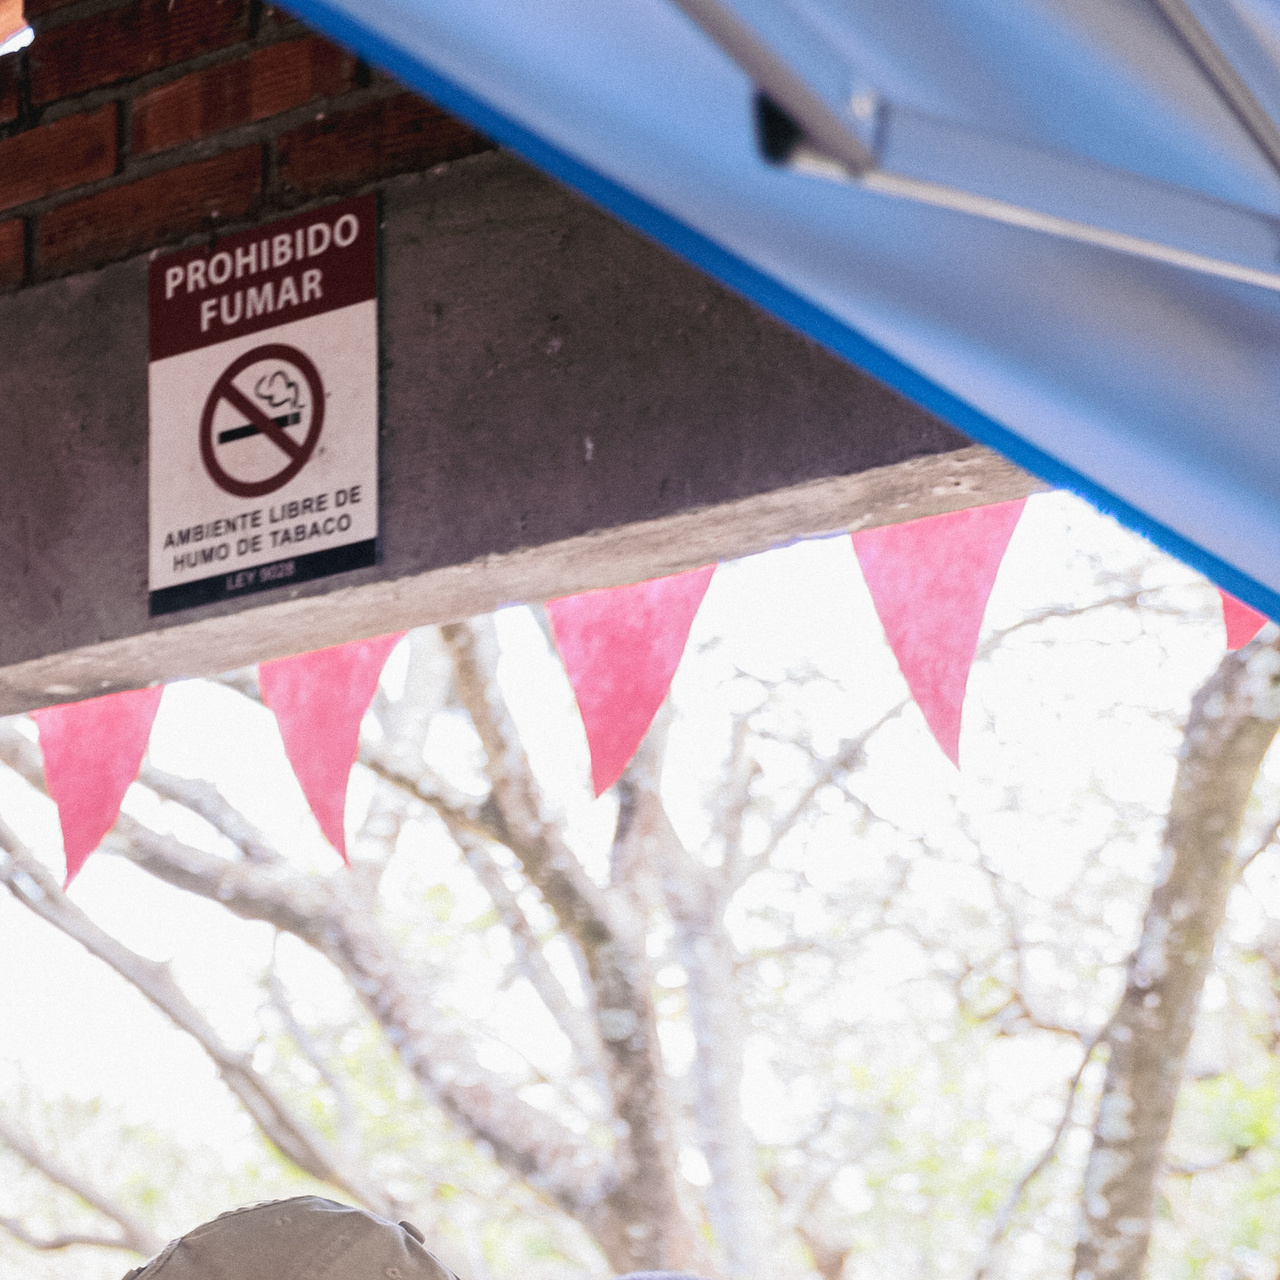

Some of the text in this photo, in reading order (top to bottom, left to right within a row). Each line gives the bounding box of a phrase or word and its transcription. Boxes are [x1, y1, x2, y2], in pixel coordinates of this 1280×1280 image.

[165, 213, 360, 301] PROHIBIDO
[200, 268, 323, 333] FUMAR
[163, 484, 363, 551] AMBIENTE LIBRE DE
[172, 513, 353, 573] HUMO DE TABACO
